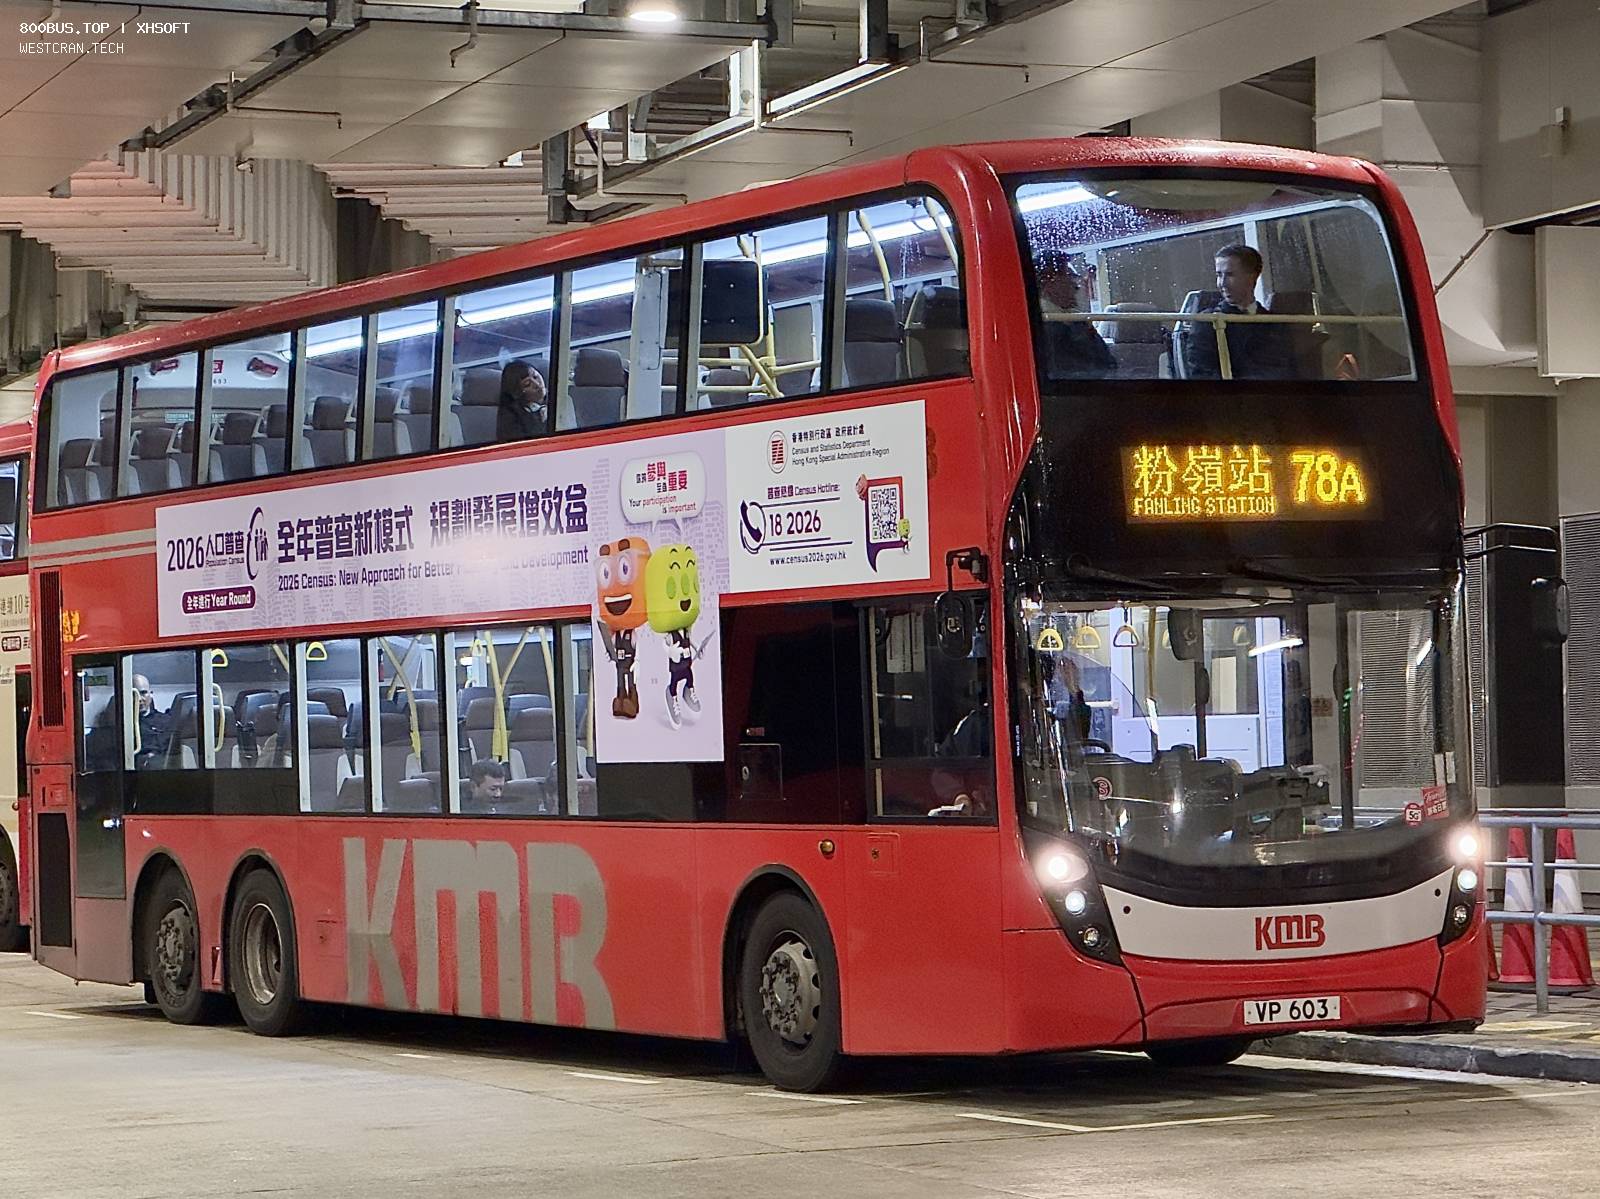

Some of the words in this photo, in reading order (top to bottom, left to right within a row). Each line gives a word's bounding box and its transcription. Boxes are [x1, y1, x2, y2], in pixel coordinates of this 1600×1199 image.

[791, 446, 810, 456] Census
[810, 444, 819, 453] and
[820, 442, 842, 451] Statistics
[842, 439, 871, 449] Department
[792, 457, 805, 467] Hong
[805, 456, 818, 465] Kong
[818, 453, 837, 464] Special
[837, 449, 872, 460] Administrative
[872, 447, 890, 458] Region
[1133, 443, 1272, 497] 粉嶺站
[1290, 451, 1366, 503] 78A
[794, 486, 817, 496] Census
[817, 483, 841, 494] Hotline:
[629, 499, 642, 508] Your
[642, 495, 677, 509] participation
[668, 501, 697, 513] important
[1133, 497, 1201, 515] FANLING
[1206, 497, 1276, 515] STATION
[277, 504, 415, 564] 全年普查新模式
[429, 483, 589, 549] 規劃發展增效益
[769, 513, 783, 536] 18
[786, 509, 822, 535] 2026
[167, 536, 205, 572] 2026
[205, 530, 245, 558] 人口普查
[769, 552, 848, 566] www.census2026.gov.hk
[278, 574, 300, 592] 2026
[301, 571, 337, 590] Census:
[339, 569, 359, 586] New
[361, 564, 405, 588] Approach
[407, 563, 422, 578] for
[210, 594, 228, 607] Year
[228, 590, 251, 605] Round
[1409, 810, 1420, 820] 5G
[342, 836, 616, 1030] KMB
[1255, 914, 1326, 951] KMB
[1255, 1002, 1281, 1022] VP
[1289, 999, 1329, 1020] 603
